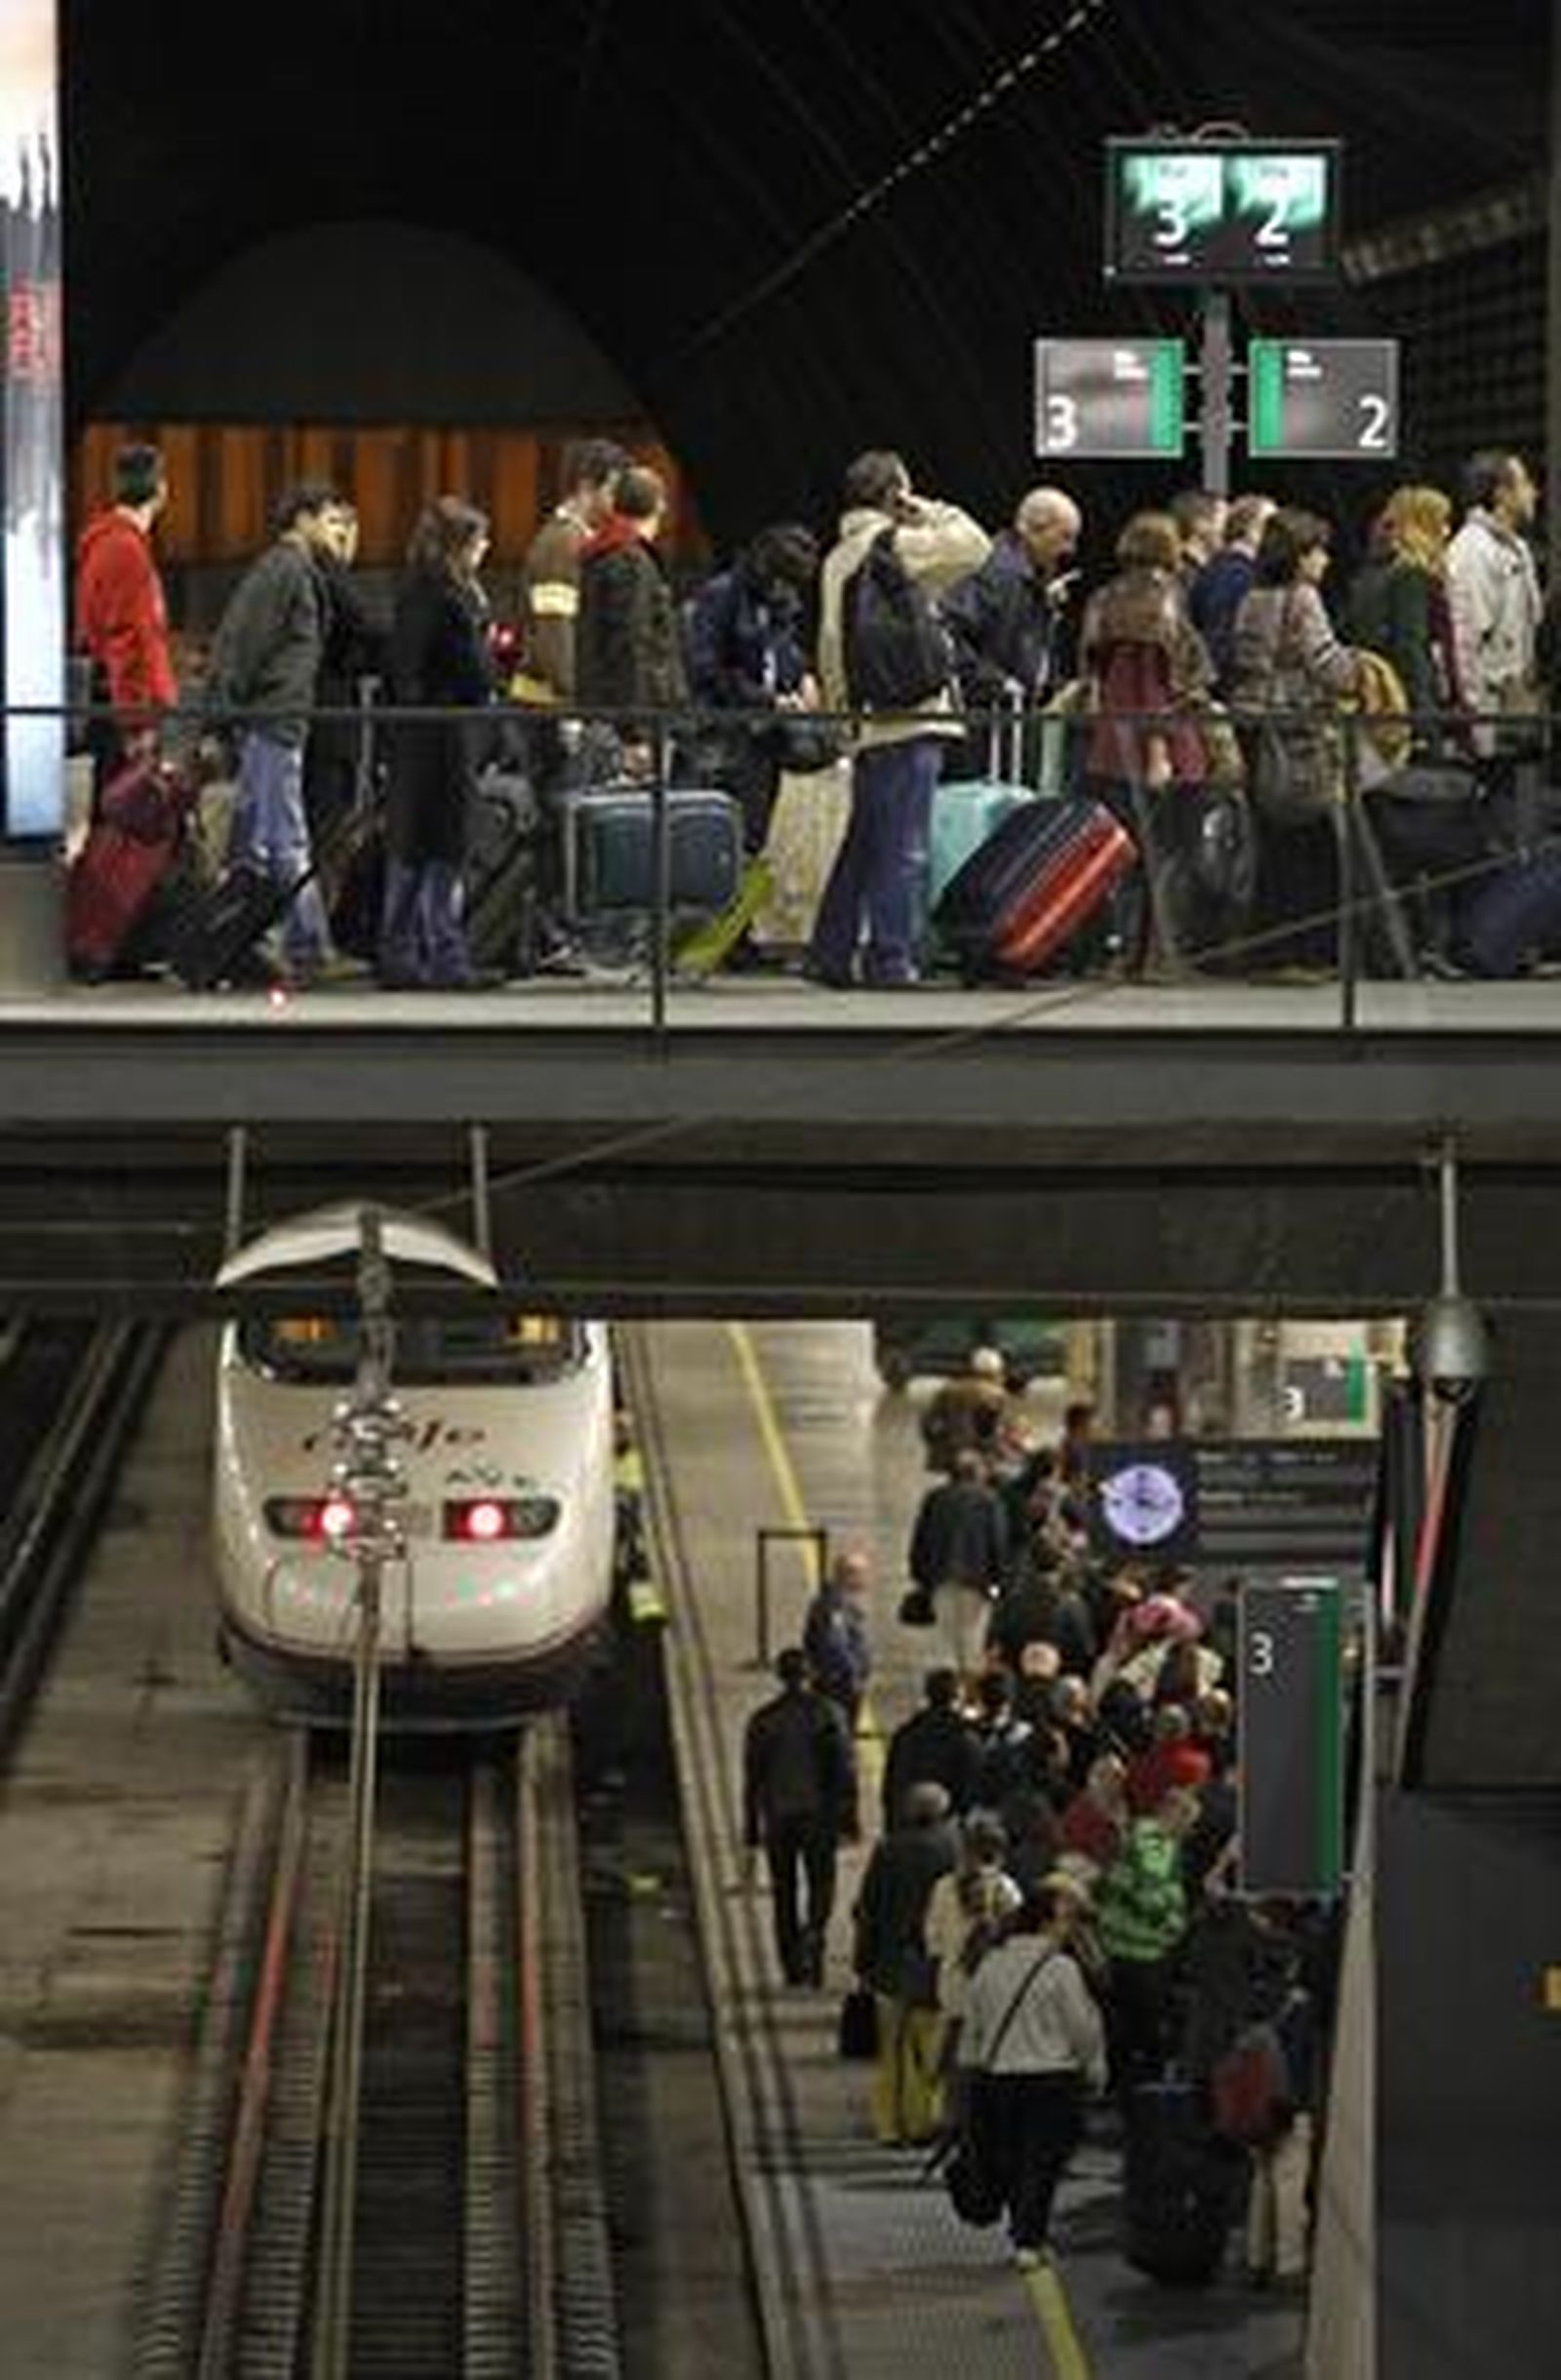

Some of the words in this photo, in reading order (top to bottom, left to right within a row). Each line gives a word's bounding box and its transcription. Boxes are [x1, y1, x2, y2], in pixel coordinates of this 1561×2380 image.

[1155, 188, 1189, 246] 3
[1255, 188, 1289, 246] 2
[1047, 395, 1076, 449] 3
[1358, 395, 1388, 448] 2
[1284, 1386, 1304, 1421] 3
[1249, 1631, 1274, 1675] 3
